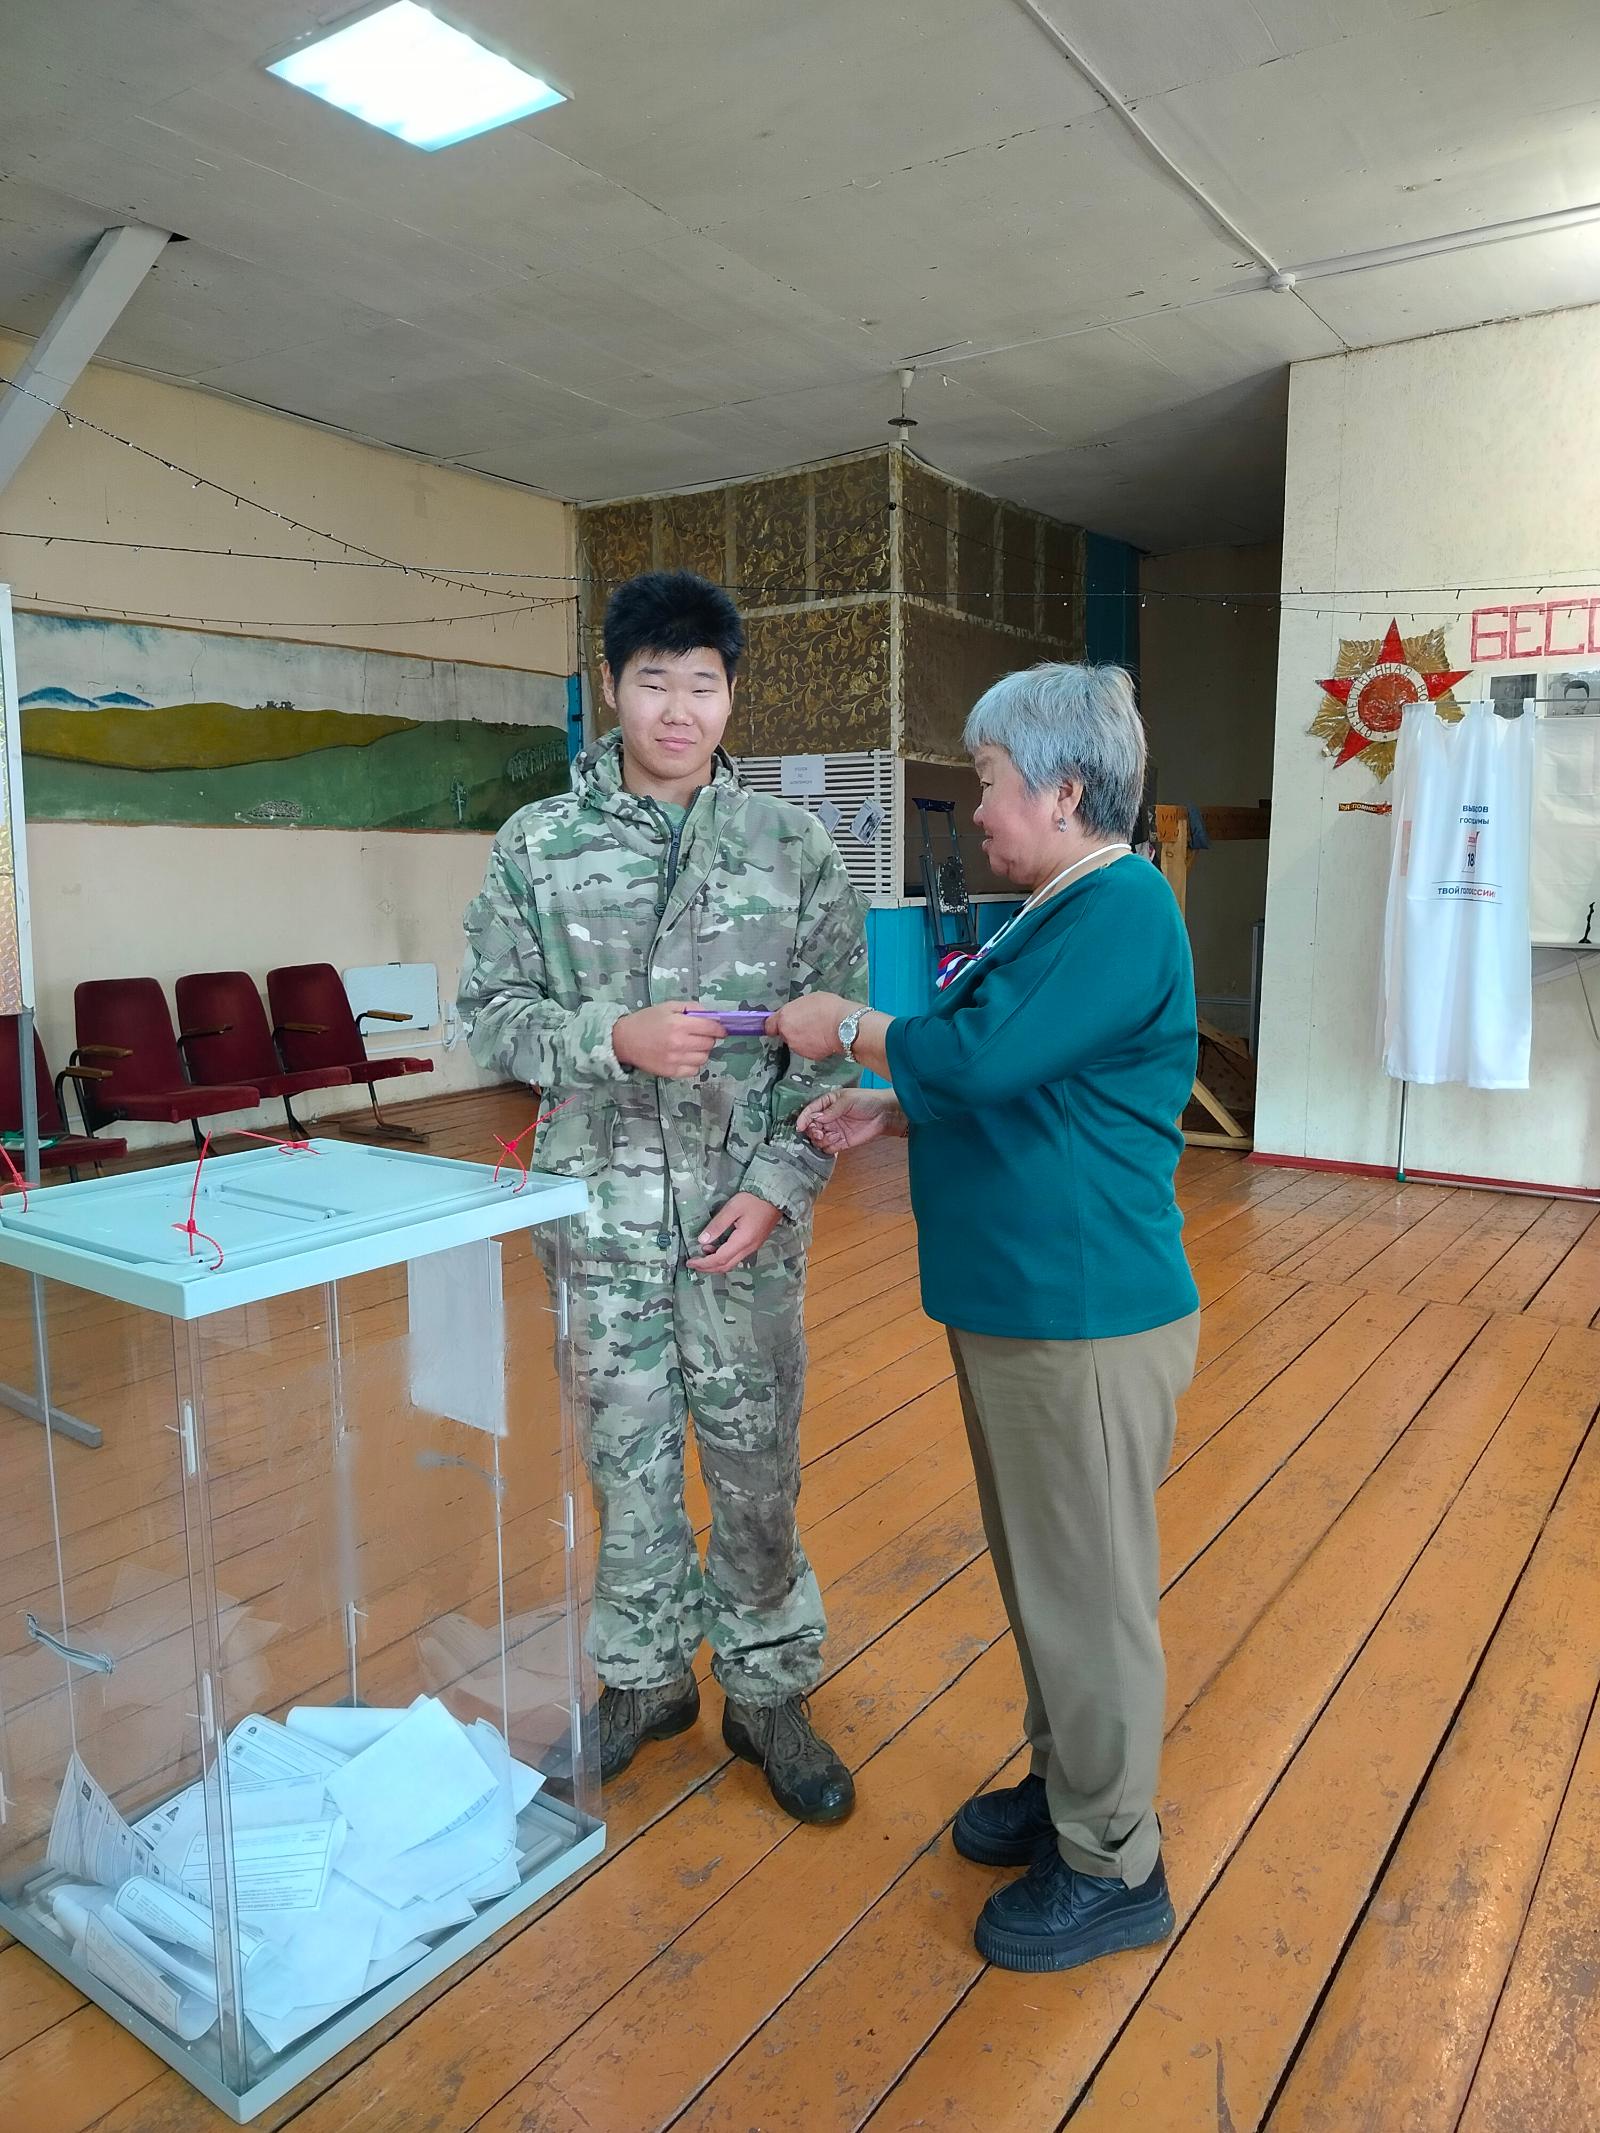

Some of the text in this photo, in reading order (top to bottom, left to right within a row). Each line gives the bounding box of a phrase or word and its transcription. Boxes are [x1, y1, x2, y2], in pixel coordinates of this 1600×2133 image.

[1349, 662, 1429, 739] ОТЕЧЕСТВЕННАЯ ВО
[1467, 853, 1475, 867] 18
[1438, 885, 1460, 895] ТВОЙ
